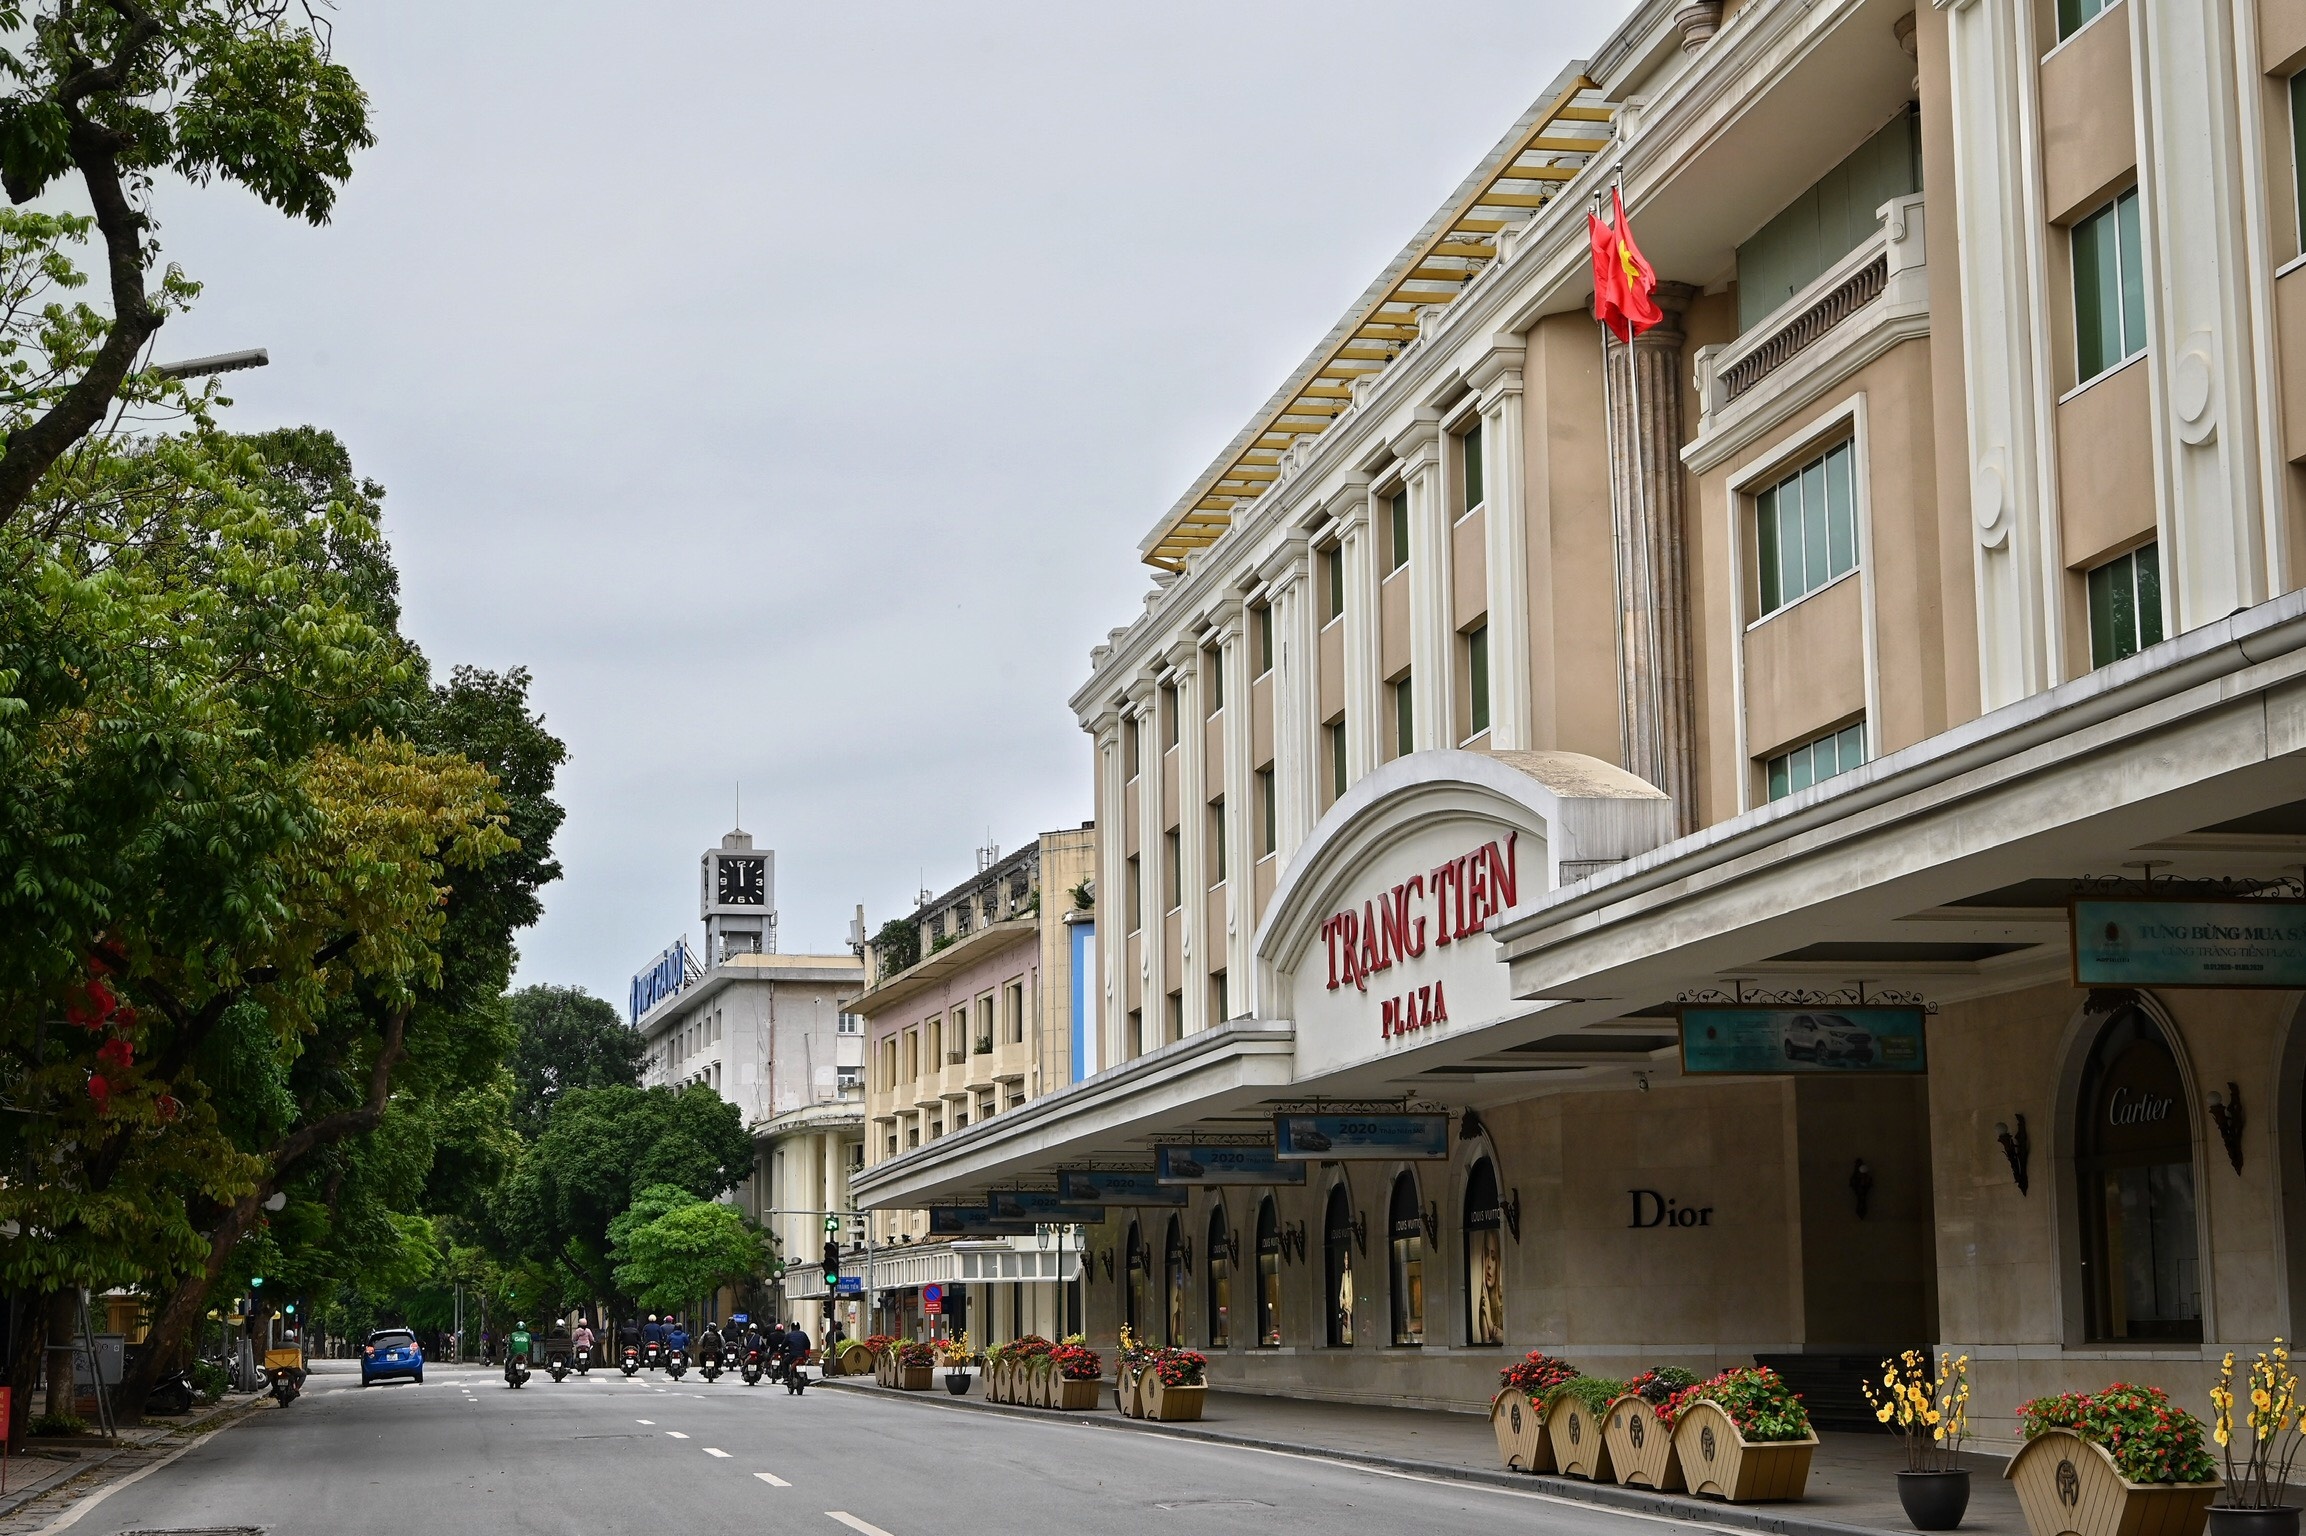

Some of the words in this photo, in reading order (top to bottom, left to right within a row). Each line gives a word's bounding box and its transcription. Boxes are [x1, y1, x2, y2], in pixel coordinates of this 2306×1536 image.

[719, 877, 728, 886] 9
[755, 878, 764, 887] 3
[737, 895, 746, 904] 6
[1321, 874, 1427, 992] TRANG
[1430, 830, 1519, 947] TIEN
[2245, 926, 2284, 941] MUA
[2264, 947, 2303, 958] PLAZA
[1381, 980, 1448, 1040] PLAZA
[2109, 1086, 2174, 1126] Cartier
[1339, 1123, 1377, 1135] 2020
[1211, 1153, 1245, 1164] 2020
[1106, 1179, 1136, 1188] 2020
[1031, 1199, 1056, 1207] 2020
[1627, 1190, 1714, 1228] Dior
[968, 1213, 988, 1221] 202
